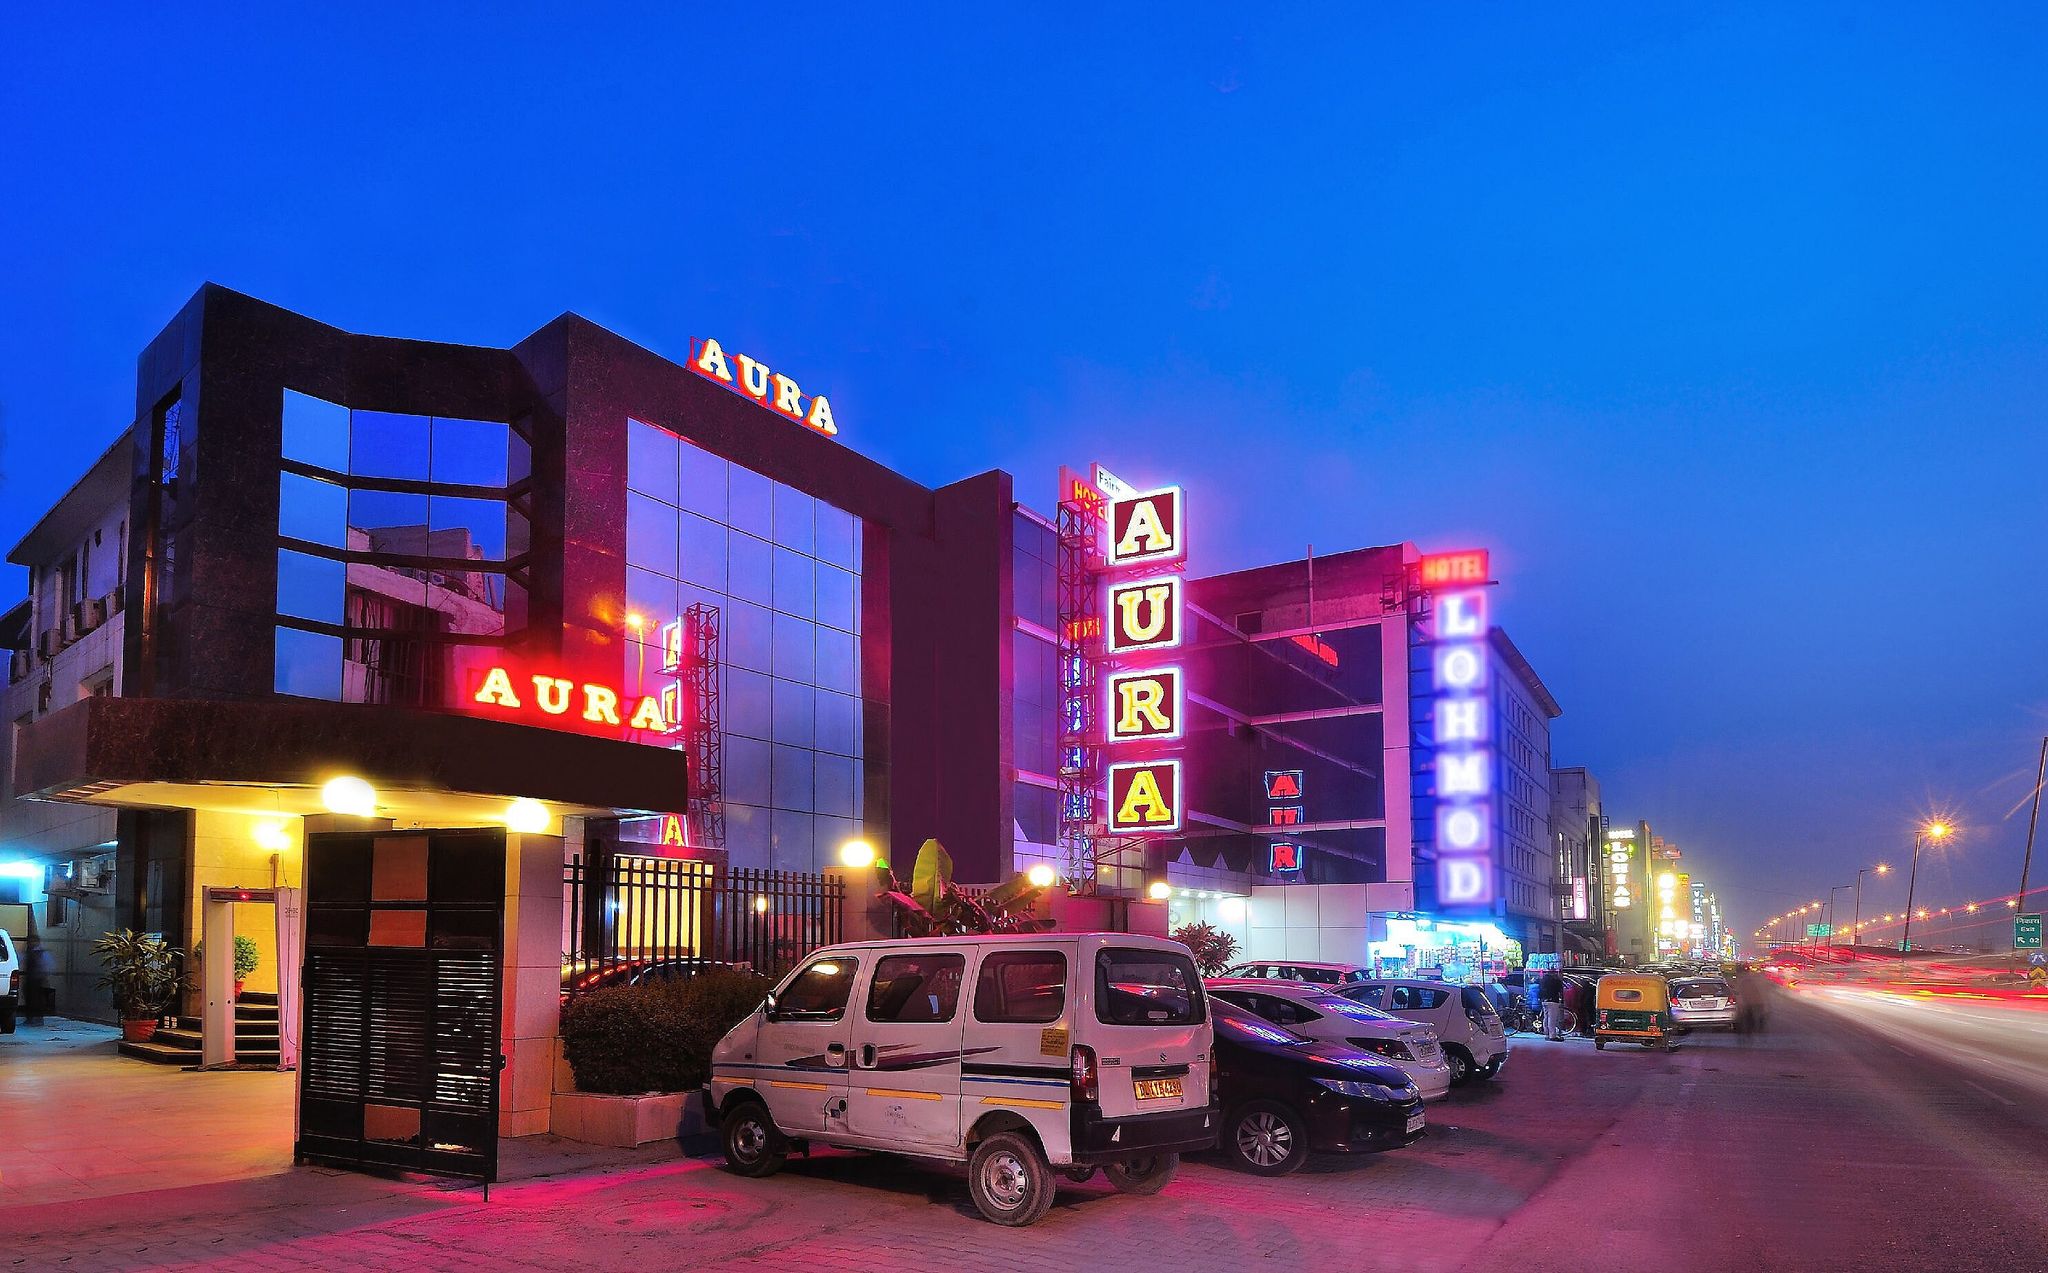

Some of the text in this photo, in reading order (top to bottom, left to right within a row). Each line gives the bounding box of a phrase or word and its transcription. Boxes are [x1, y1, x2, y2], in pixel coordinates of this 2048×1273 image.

[697, 338, 838, 436] AURA
[1423, 554, 1485, 582] HOTEL
[474, 667, 667, 732] AURA
[1116, 500, 1172, 823] AURA
